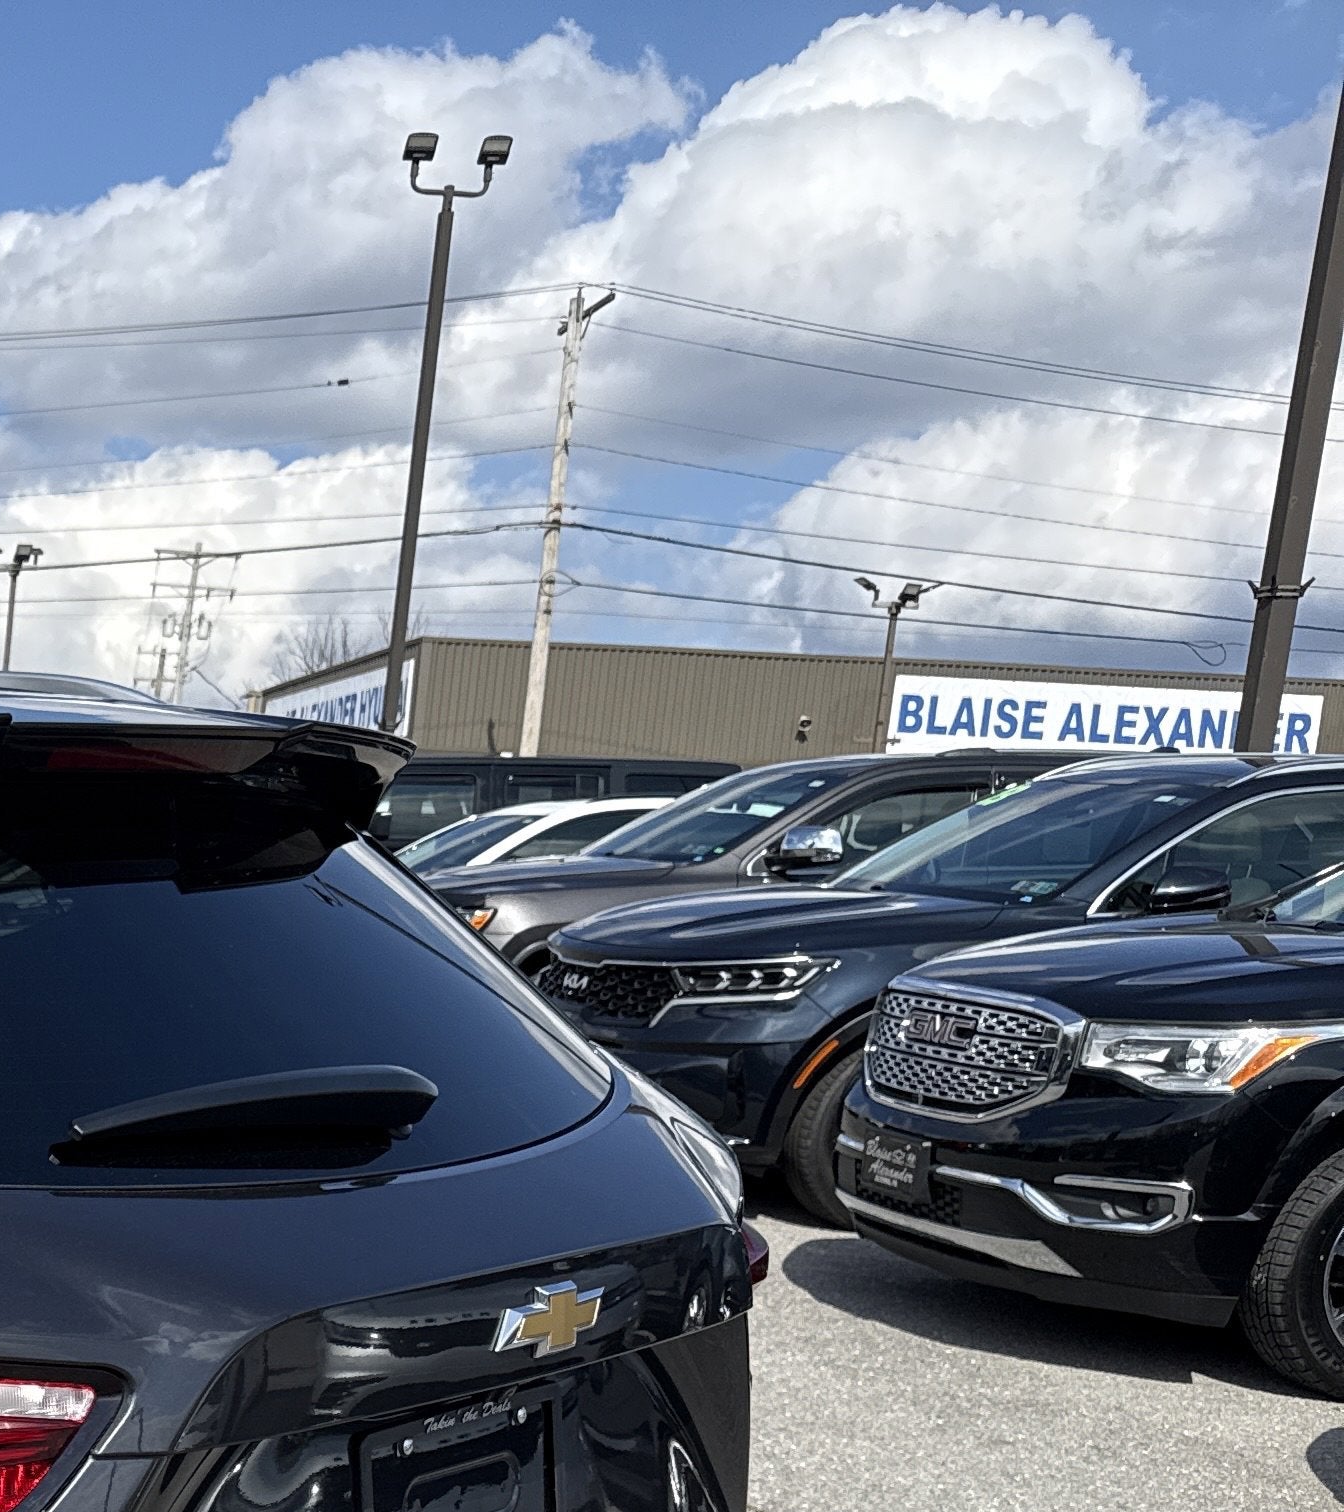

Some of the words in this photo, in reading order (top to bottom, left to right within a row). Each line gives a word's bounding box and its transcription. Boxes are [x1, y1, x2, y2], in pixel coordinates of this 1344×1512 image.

[897, 693, 1048, 740] BLAISE
[1057, 702, 1312, 754] ALEXANR
[907, 1010, 979, 1047] GMC
[462, 1404, 480, 1424] the
